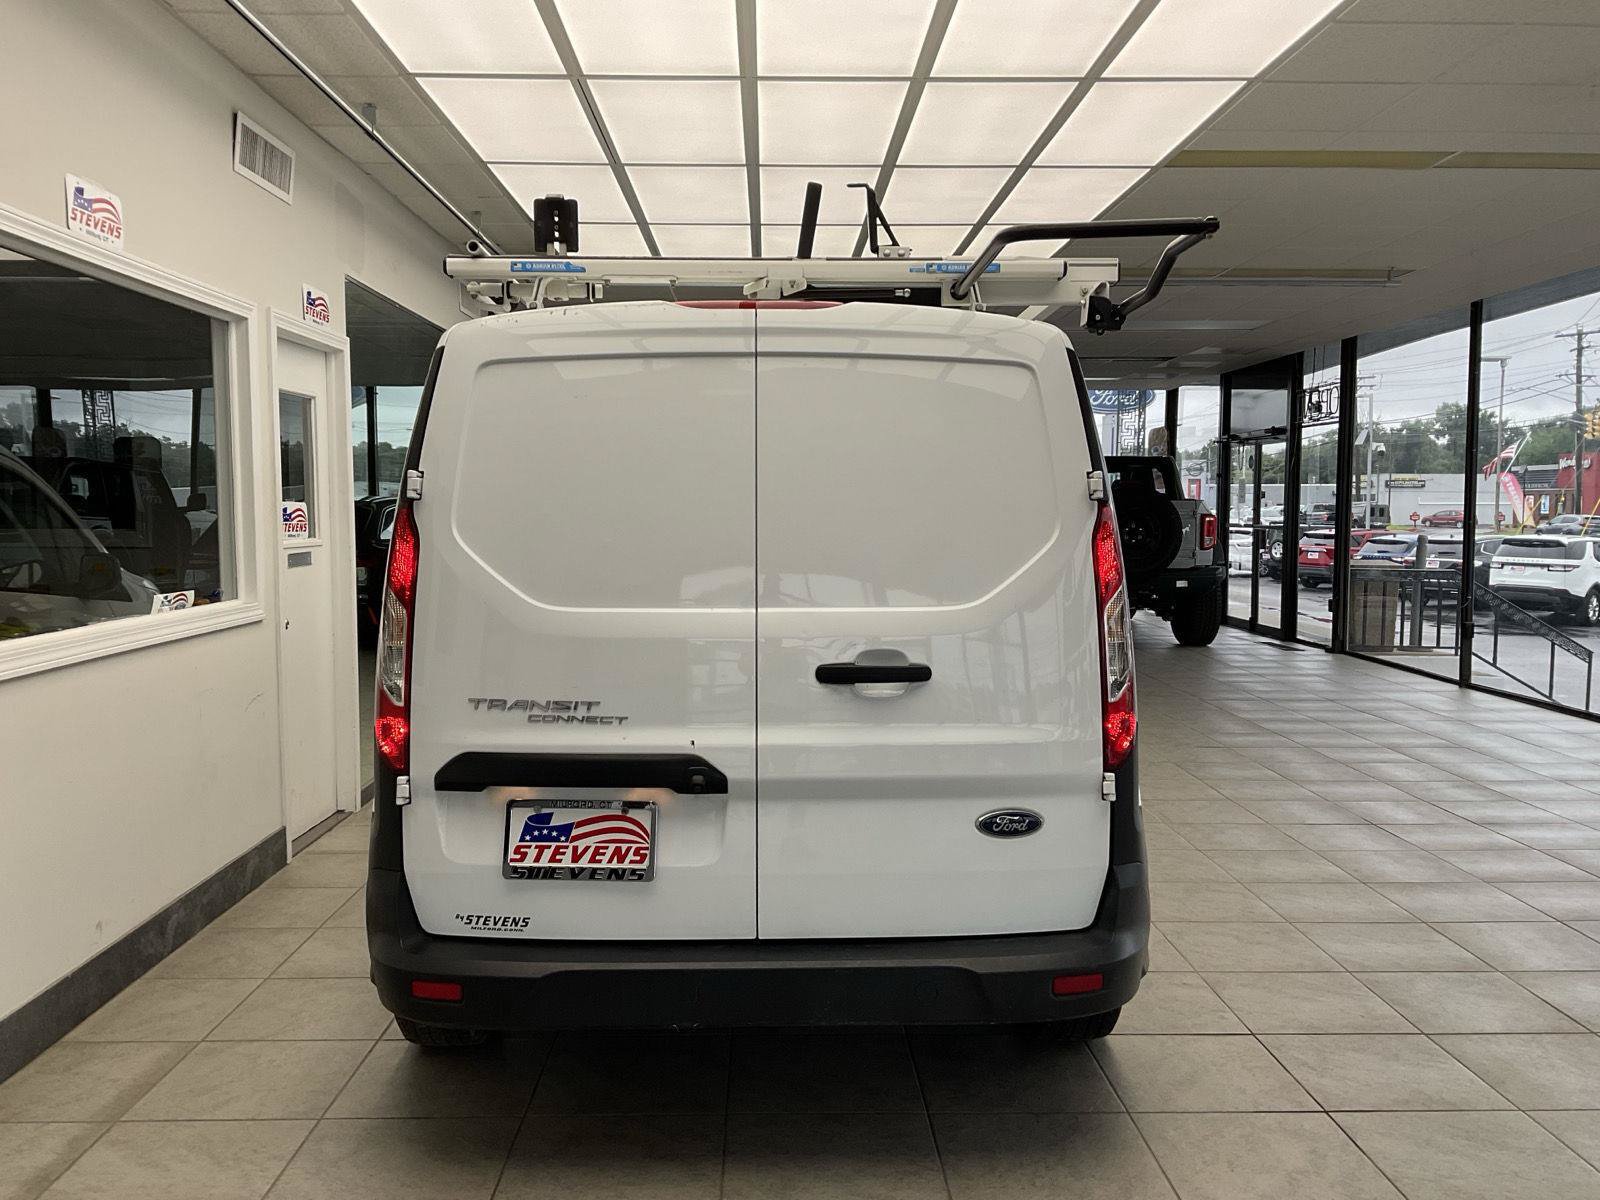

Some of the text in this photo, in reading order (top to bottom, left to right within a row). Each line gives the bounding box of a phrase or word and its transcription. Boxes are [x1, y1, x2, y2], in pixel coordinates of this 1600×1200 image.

[70, 207, 122, 240] STEVENS
[305, 305, 330, 323] STEVENS
[283, 523, 307, 532] TEVENS
[468, 697, 600, 713] TRANSIT
[527, 714, 628, 725] CONNECT
[992, 815, 1029, 831] Ford
[509, 844, 649, 864] STEVENS
[509, 866, 647, 880] STEVENS
[464, 914, 531, 928] STEVENS
